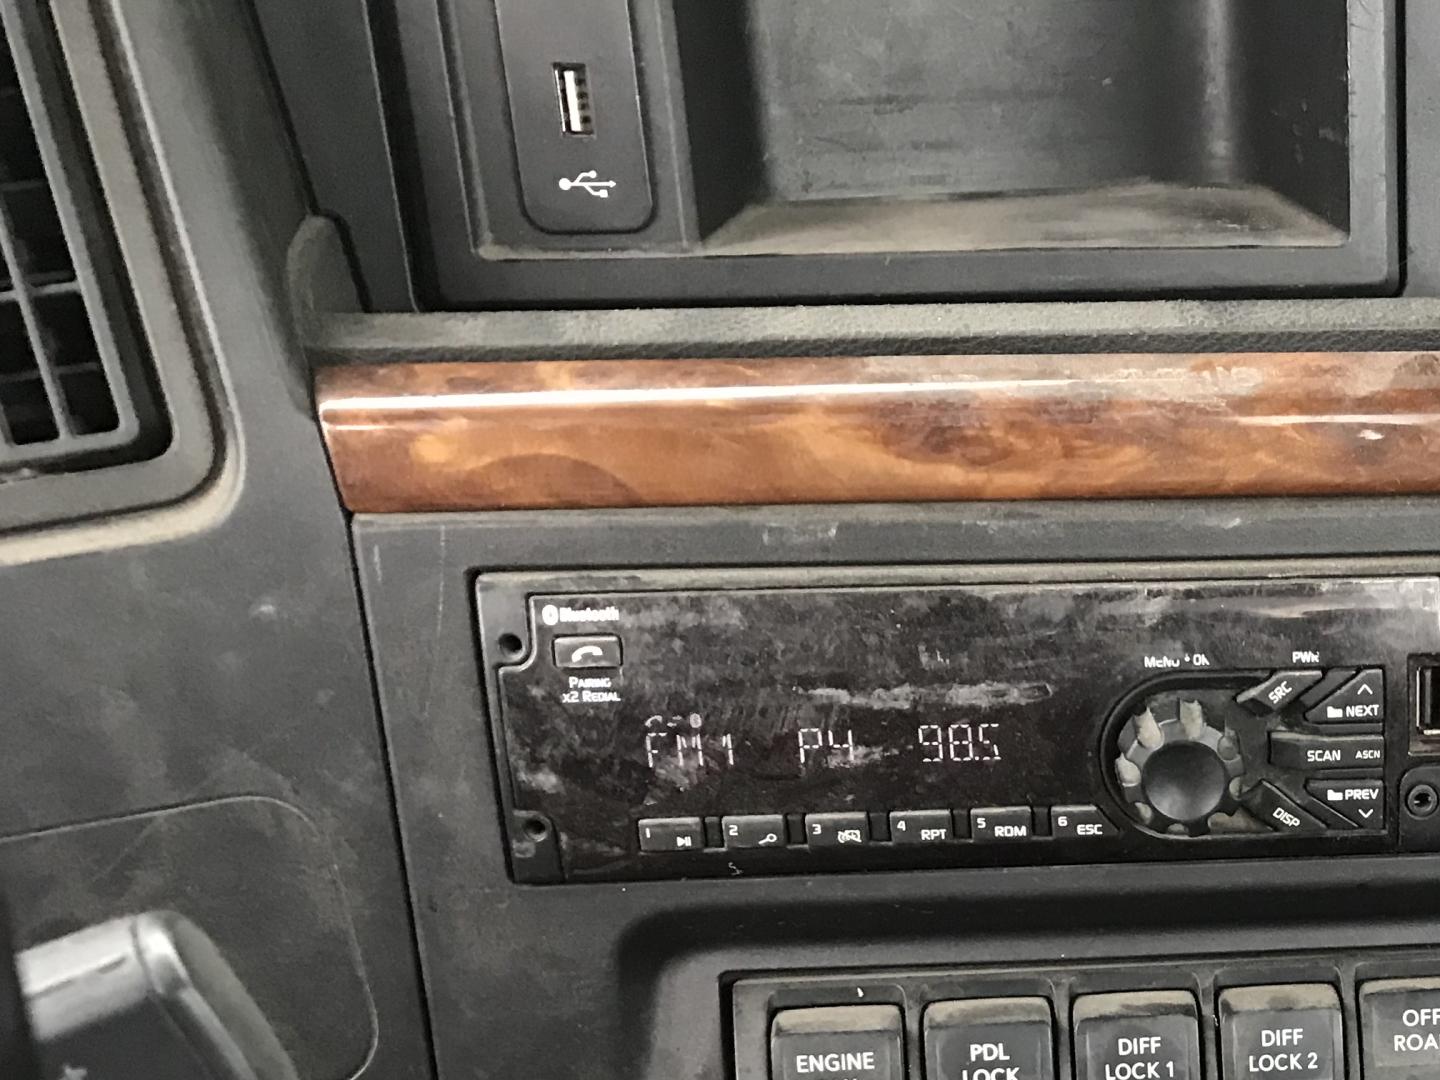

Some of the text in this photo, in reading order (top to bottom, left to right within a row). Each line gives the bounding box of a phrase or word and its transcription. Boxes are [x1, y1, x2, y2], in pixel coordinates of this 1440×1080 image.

[1268, 680, 1293, 704] SRC
[1345, 704, 1380, 717] NEXT
[798, 727, 854, 763] P4
[1306, 749, 1381, 762] SCAN ASCN
[1344, 788, 1379, 801] PREV
[976, 817, 1027, 837] 5 RDM
[1057, 815, 1103, 836] 6 ESC
[1272, 807, 1301, 828] DISP
[728, 824, 739, 836] 2
[811, 823, 822, 835] 3
[896, 820, 947, 841] 4 RPT
[1117, 1036, 1162, 1056] DIFF
[1261, 1028, 1304, 1048] DIFF
[969, 1042, 1011, 1062] PDL
[1248, 1051, 1318, 1072] LOCK 2
[796, 1051, 876, 1074] ENGINE
[1105, 1061, 1174, 1080] LOCK 1
